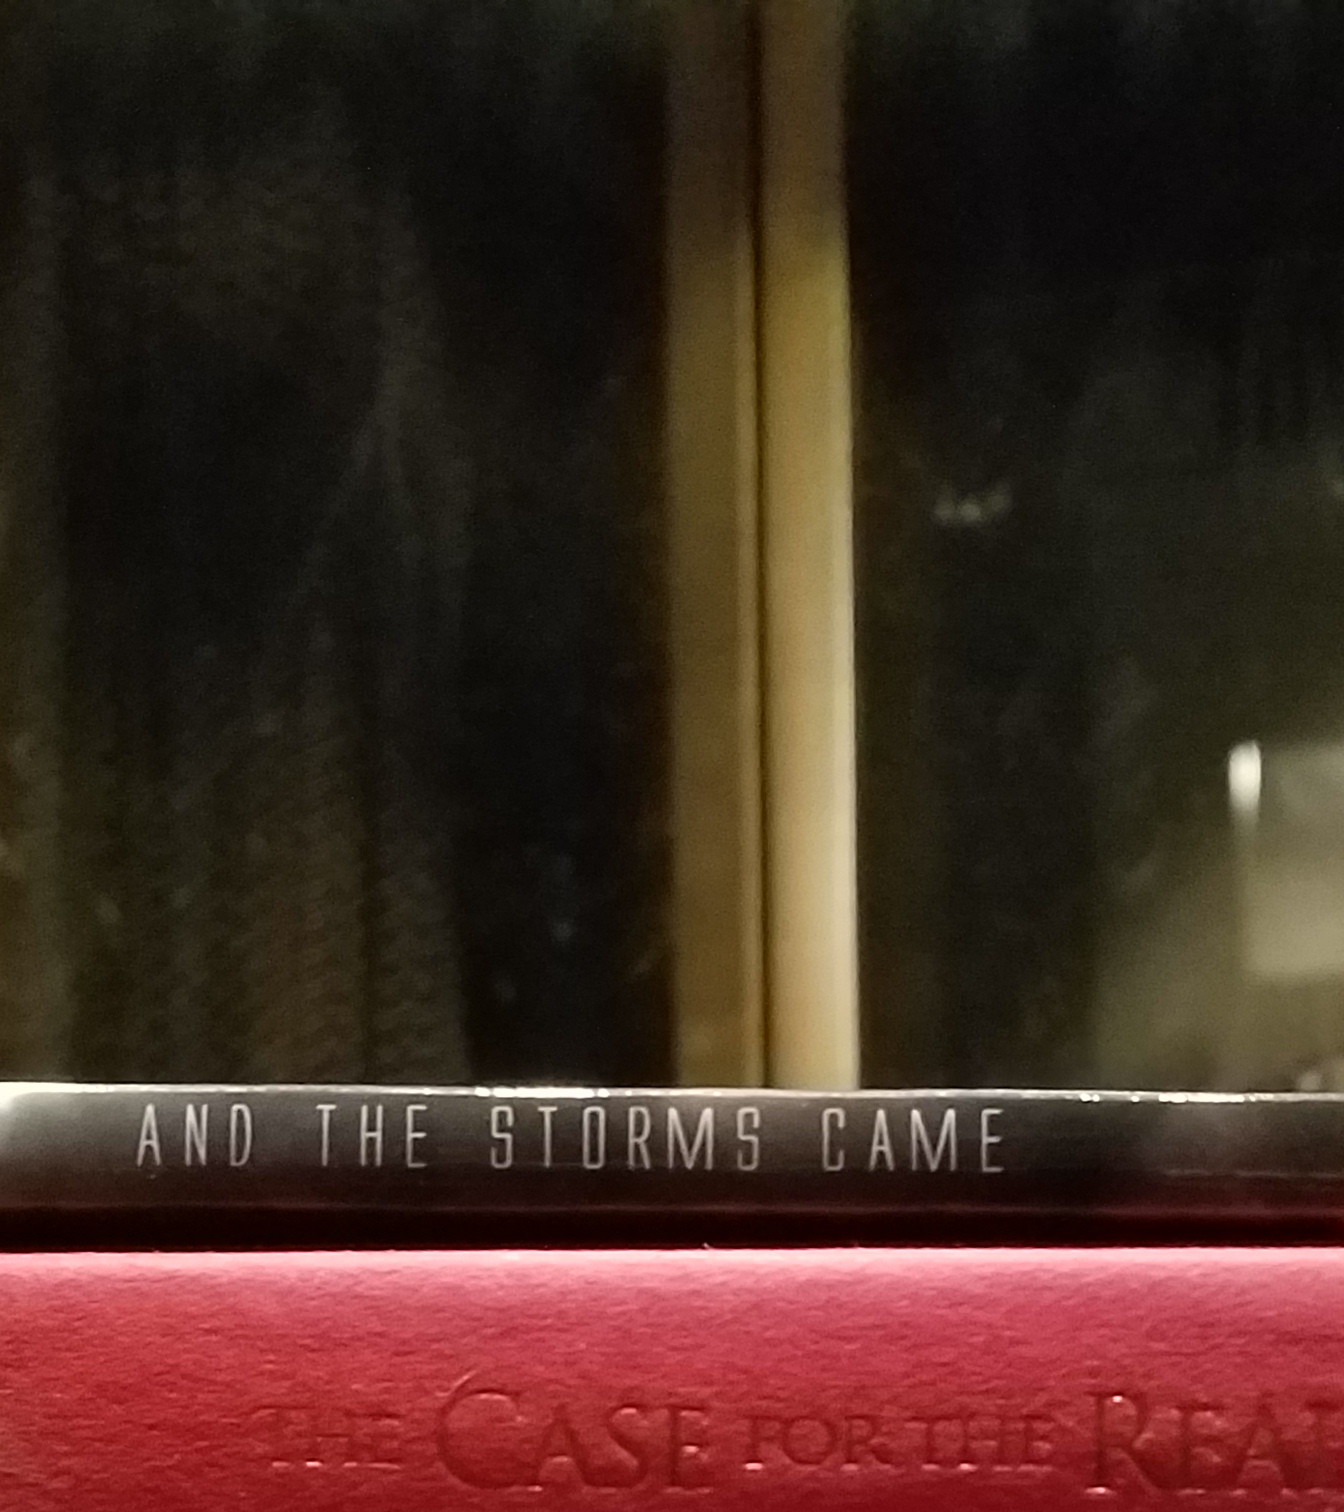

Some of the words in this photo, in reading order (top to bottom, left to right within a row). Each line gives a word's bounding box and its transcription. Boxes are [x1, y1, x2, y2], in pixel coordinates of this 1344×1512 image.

[136, 1102, 254, 1168] AND
[315, 1103, 430, 1169] THE
[489, 1105, 763, 1172] STORMS
[820, 1107, 1006, 1173] CAME
[436, 1388, 715, 1493] CASE
[743, 1412, 897, 1472] FOR
[905, 1410, 1054, 1472] THE
